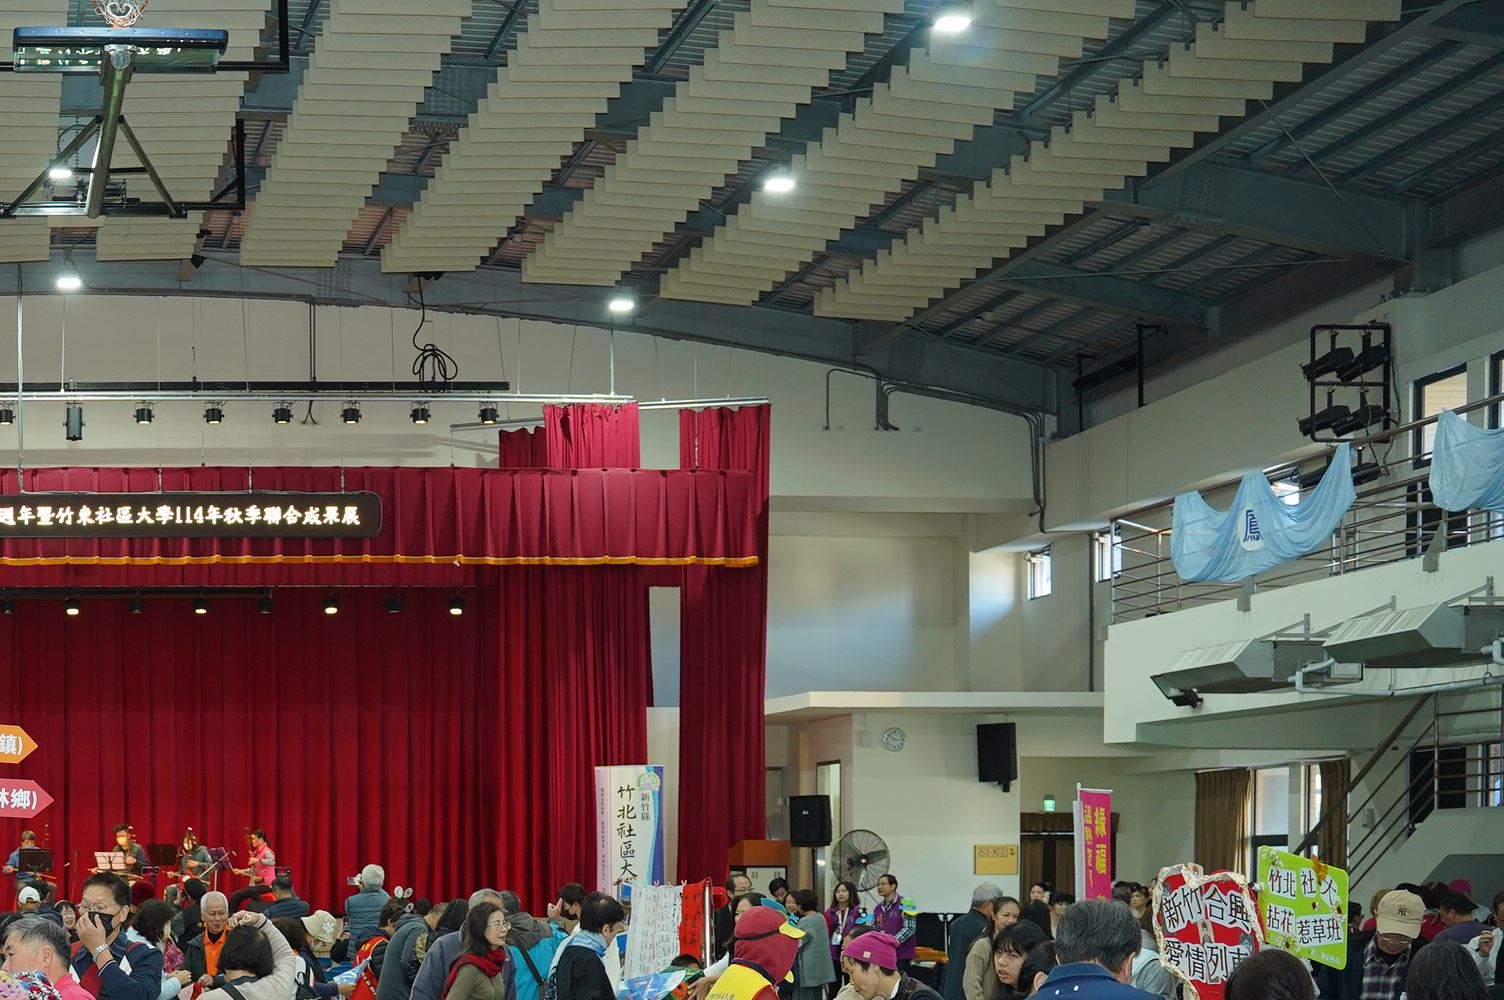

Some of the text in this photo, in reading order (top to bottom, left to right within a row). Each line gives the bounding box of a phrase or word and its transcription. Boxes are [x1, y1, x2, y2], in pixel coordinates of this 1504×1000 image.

[617, 784, 638, 885] 竹北社區大
